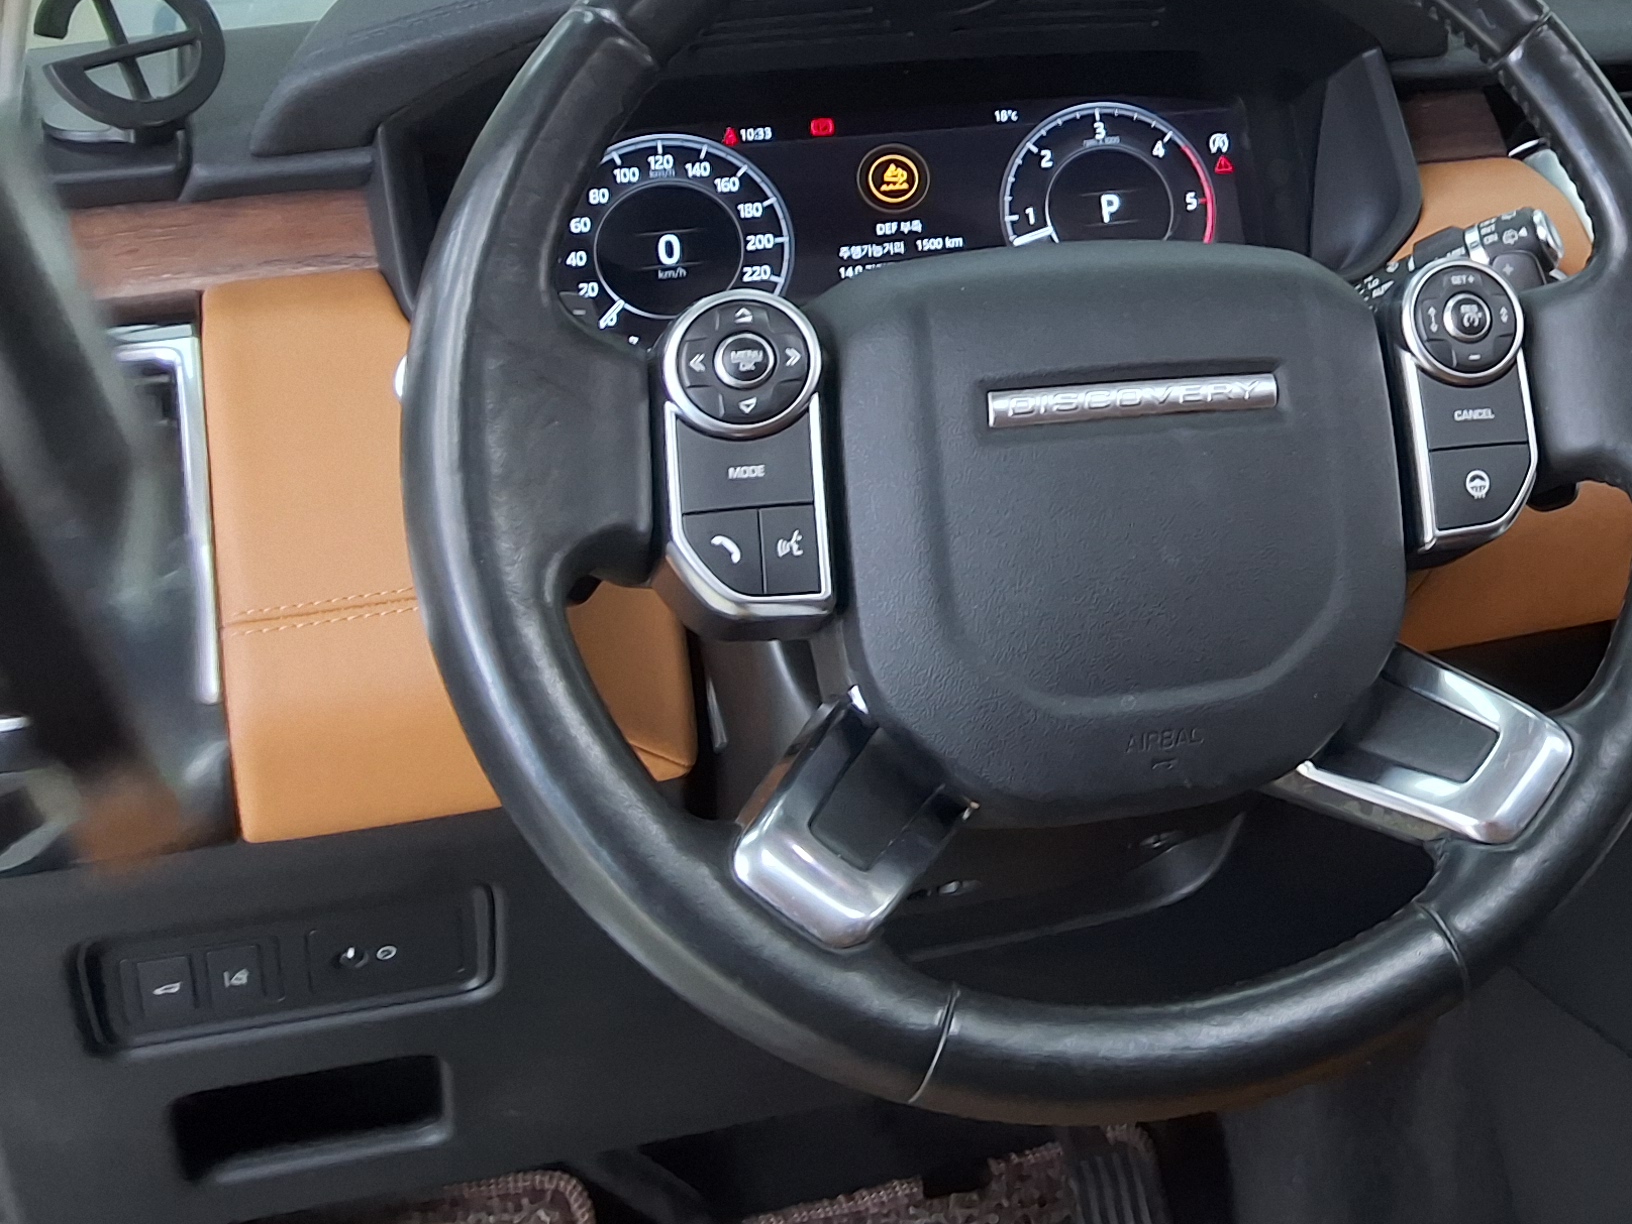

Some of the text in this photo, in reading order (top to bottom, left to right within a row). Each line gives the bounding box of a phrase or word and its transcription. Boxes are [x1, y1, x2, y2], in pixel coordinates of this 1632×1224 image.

[1093, 122, 1106, 139] 3
[1152, 140, 1165, 158] 4
[648, 154, 674, 171] 120
[1040, 150, 1054, 168] 2
[613, 167, 639, 183] 100
[685, 161, 711, 177] 140
[714, 176, 740, 193] 160
[588, 188, 610, 204] 80
[1185, 192, 1198, 211] 5
[737, 202, 763, 219] 180
[1025, 207, 1035, 225] 1
[1100, 194, 1120, 224] P
[569, 217, 591, 234] 60
[657, 233, 681, 266] 0
[746, 234, 774, 251] 200
[915, 238, 943, 251] 1500
[945, 236, 963, 249] km
[566, 251, 587, 267] 40
[657, 268, 687, 279] km/h
[743, 265, 771, 282] 220
[578, 282, 599, 298] 20
[1007, 380, 1259, 417] DISCOVERY
[1454, 408, 1495, 421] CANCEL
[728, 464, 765, 479] MODE
